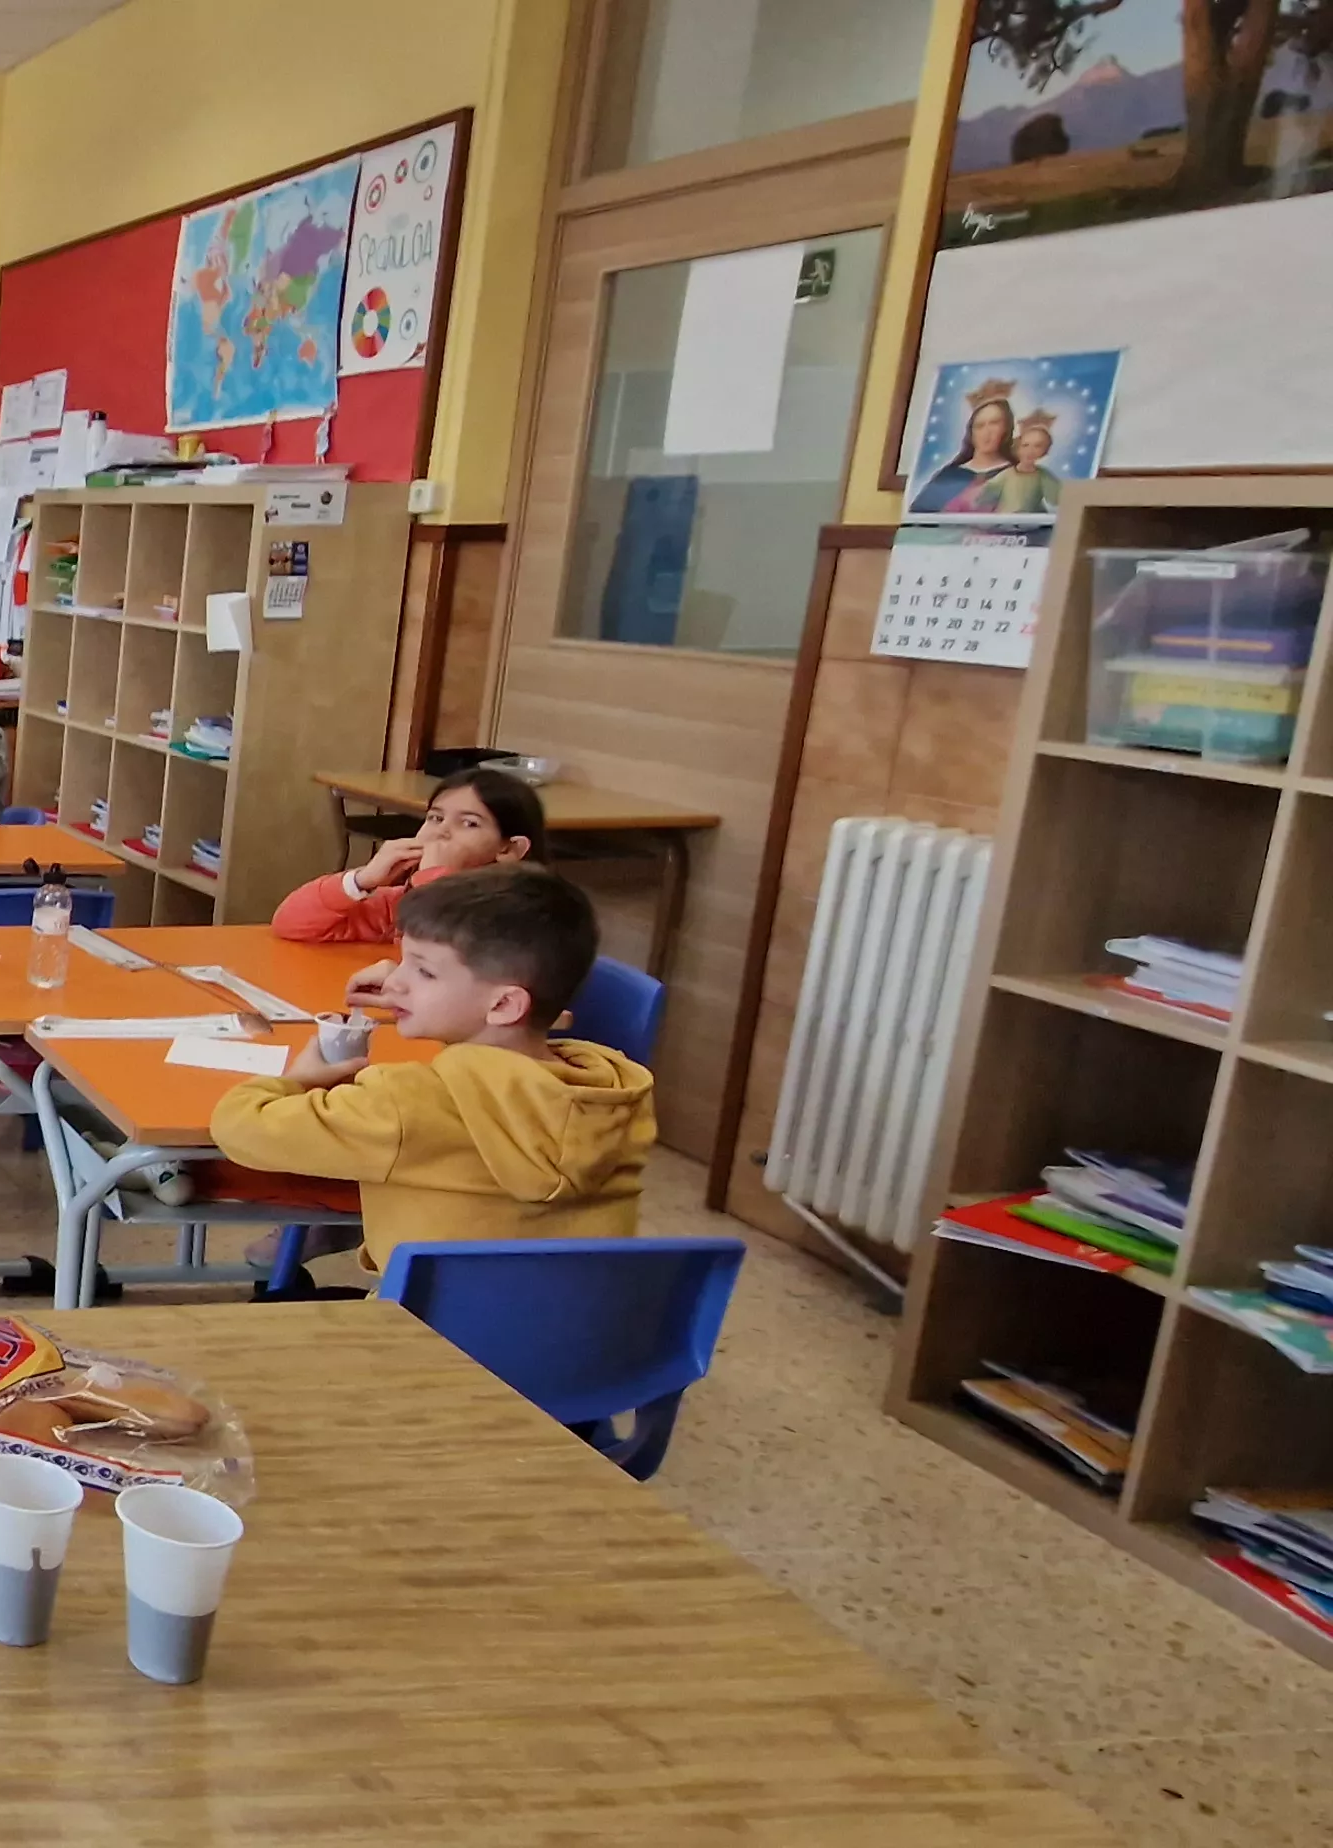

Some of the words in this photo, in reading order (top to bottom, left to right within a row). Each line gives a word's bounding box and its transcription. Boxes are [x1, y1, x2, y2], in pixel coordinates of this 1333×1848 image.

[916, 575, 924, 586] 4
[940, 575, 949, 588] 5
[963, 577, 972, 588] 6
[989, 577, 998, 589] 7
[910, 594, 921, 606] 11
[933, 594, 945, 608] 12
[956, 597, 969, 609] 13
[980, 599, 993, 611] 14
[1004, 600, 1017, 612] 15
[903, 614, 916, 626] 18
[925, 616, 939, 627] 19
[946, 617, 963, 630] 20
[994, 621, 1011, 633] 22
[896, 634, 910, 647] 25
[917, 636, 932, 648] 26
[940, 638, 956, 650] 27
[963, 640, 980, 652] 28
